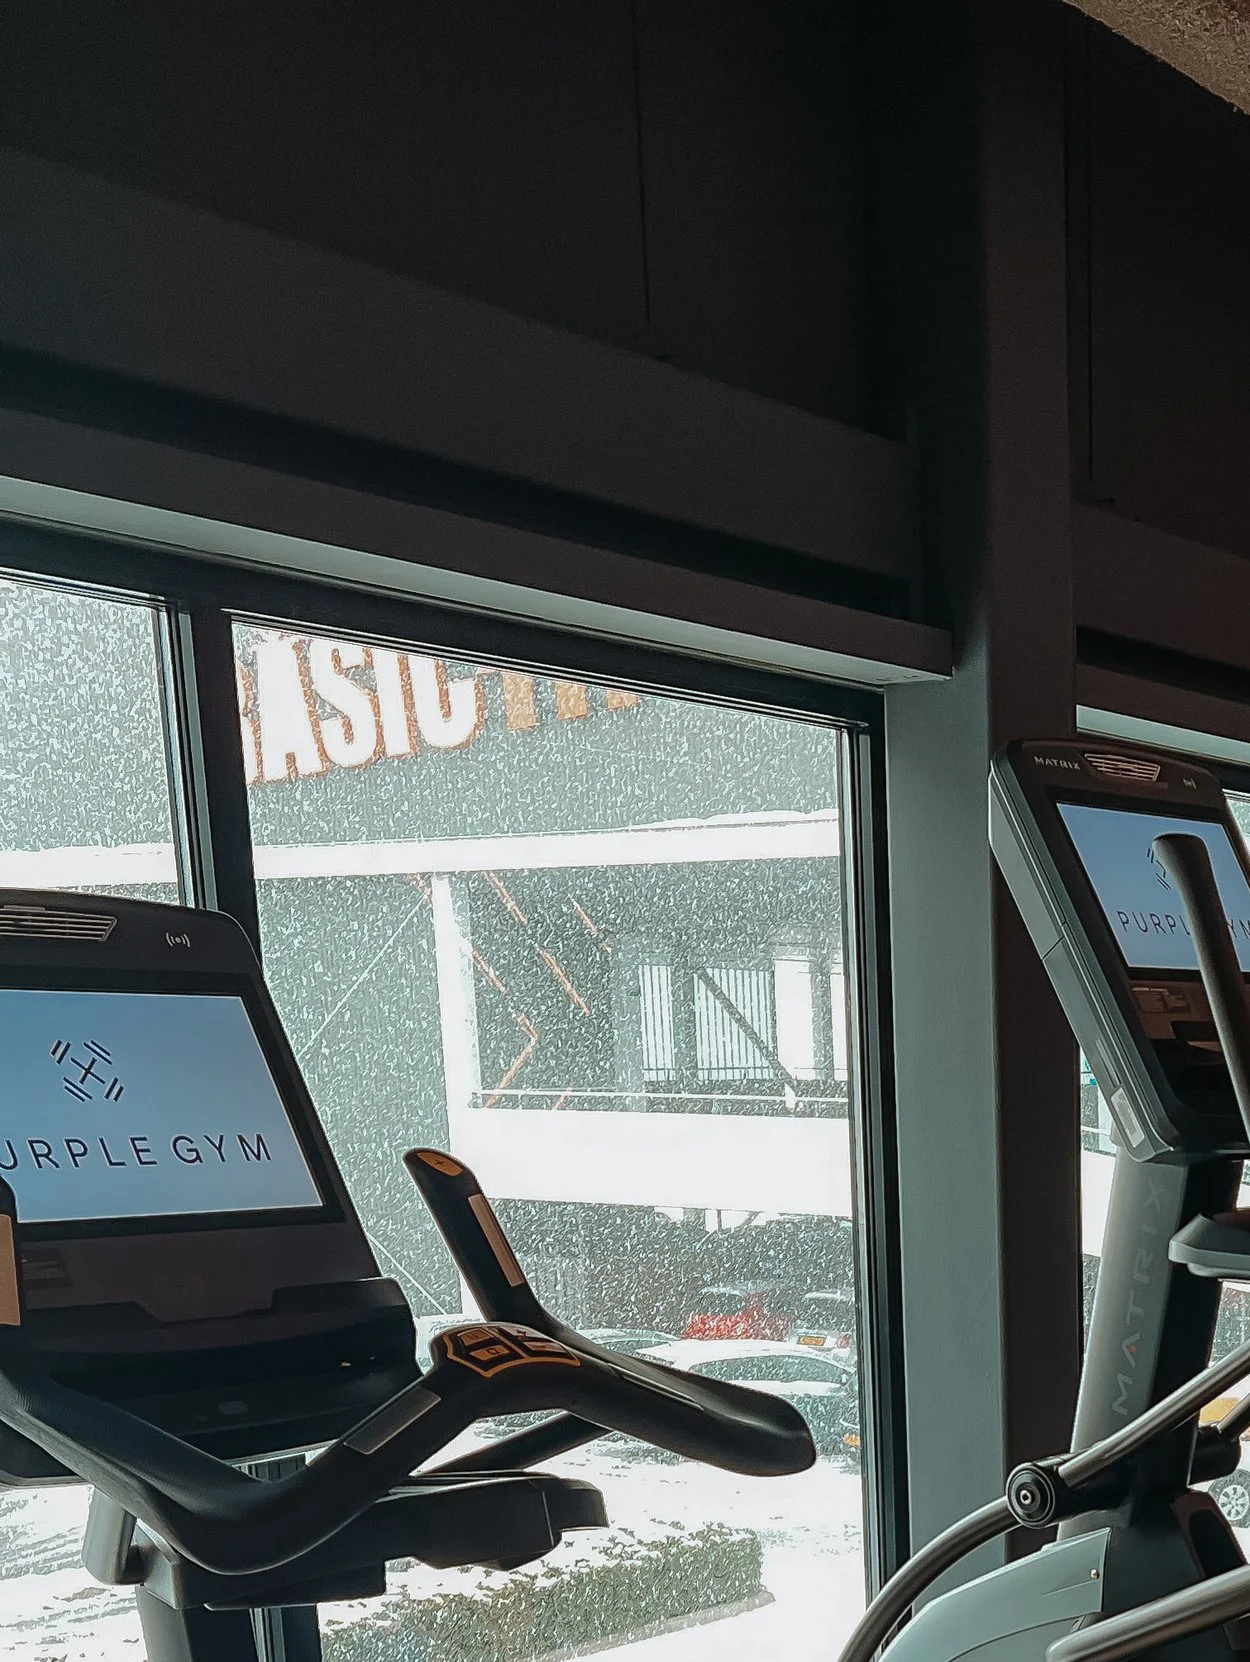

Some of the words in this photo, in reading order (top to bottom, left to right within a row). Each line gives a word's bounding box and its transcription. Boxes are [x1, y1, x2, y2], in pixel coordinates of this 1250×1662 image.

[235, 630, 487, 787] ASIC
[1033, 755, 1081, 771] MATRIX
[1116, 910, 1191, 936] PURPL
[0, 1135, 158, 1171] URPLE
[171, 1133, 272, 1165] GYM
[1111, 1176, 1168, 1417] MATRIX
